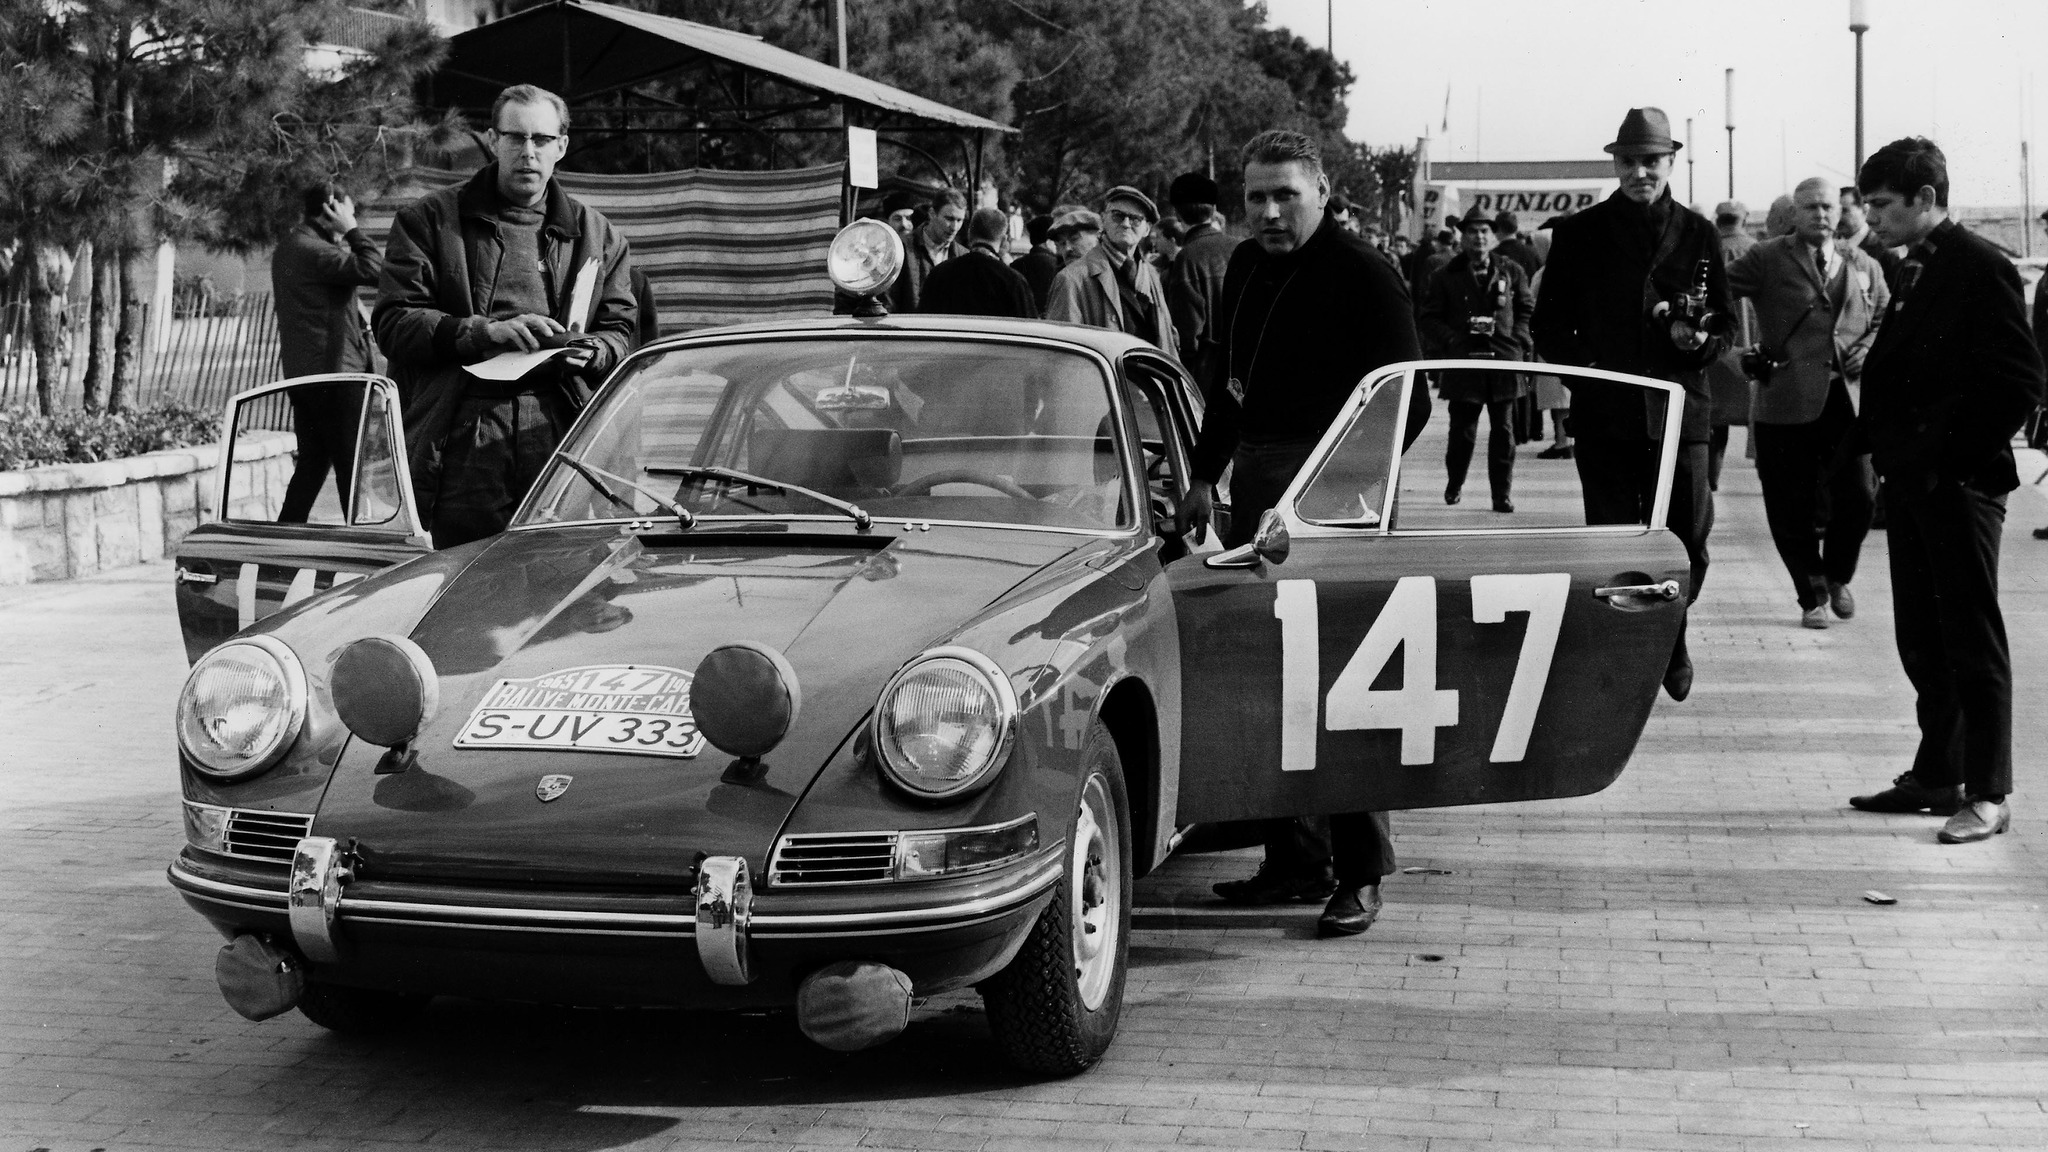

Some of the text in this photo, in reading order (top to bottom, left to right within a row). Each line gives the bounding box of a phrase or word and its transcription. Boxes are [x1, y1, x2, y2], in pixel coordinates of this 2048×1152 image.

[1474, 192, 1594, 213] DUNLOP
[580, 670, 666, 692] 147
[661, 675, 691, 694] 196
[1274, 573, 1571, 771] 147
[488, 684, 691, 714] RALLYE MONTE-CAR
[470, 713, 698, 748] S-UV 333
